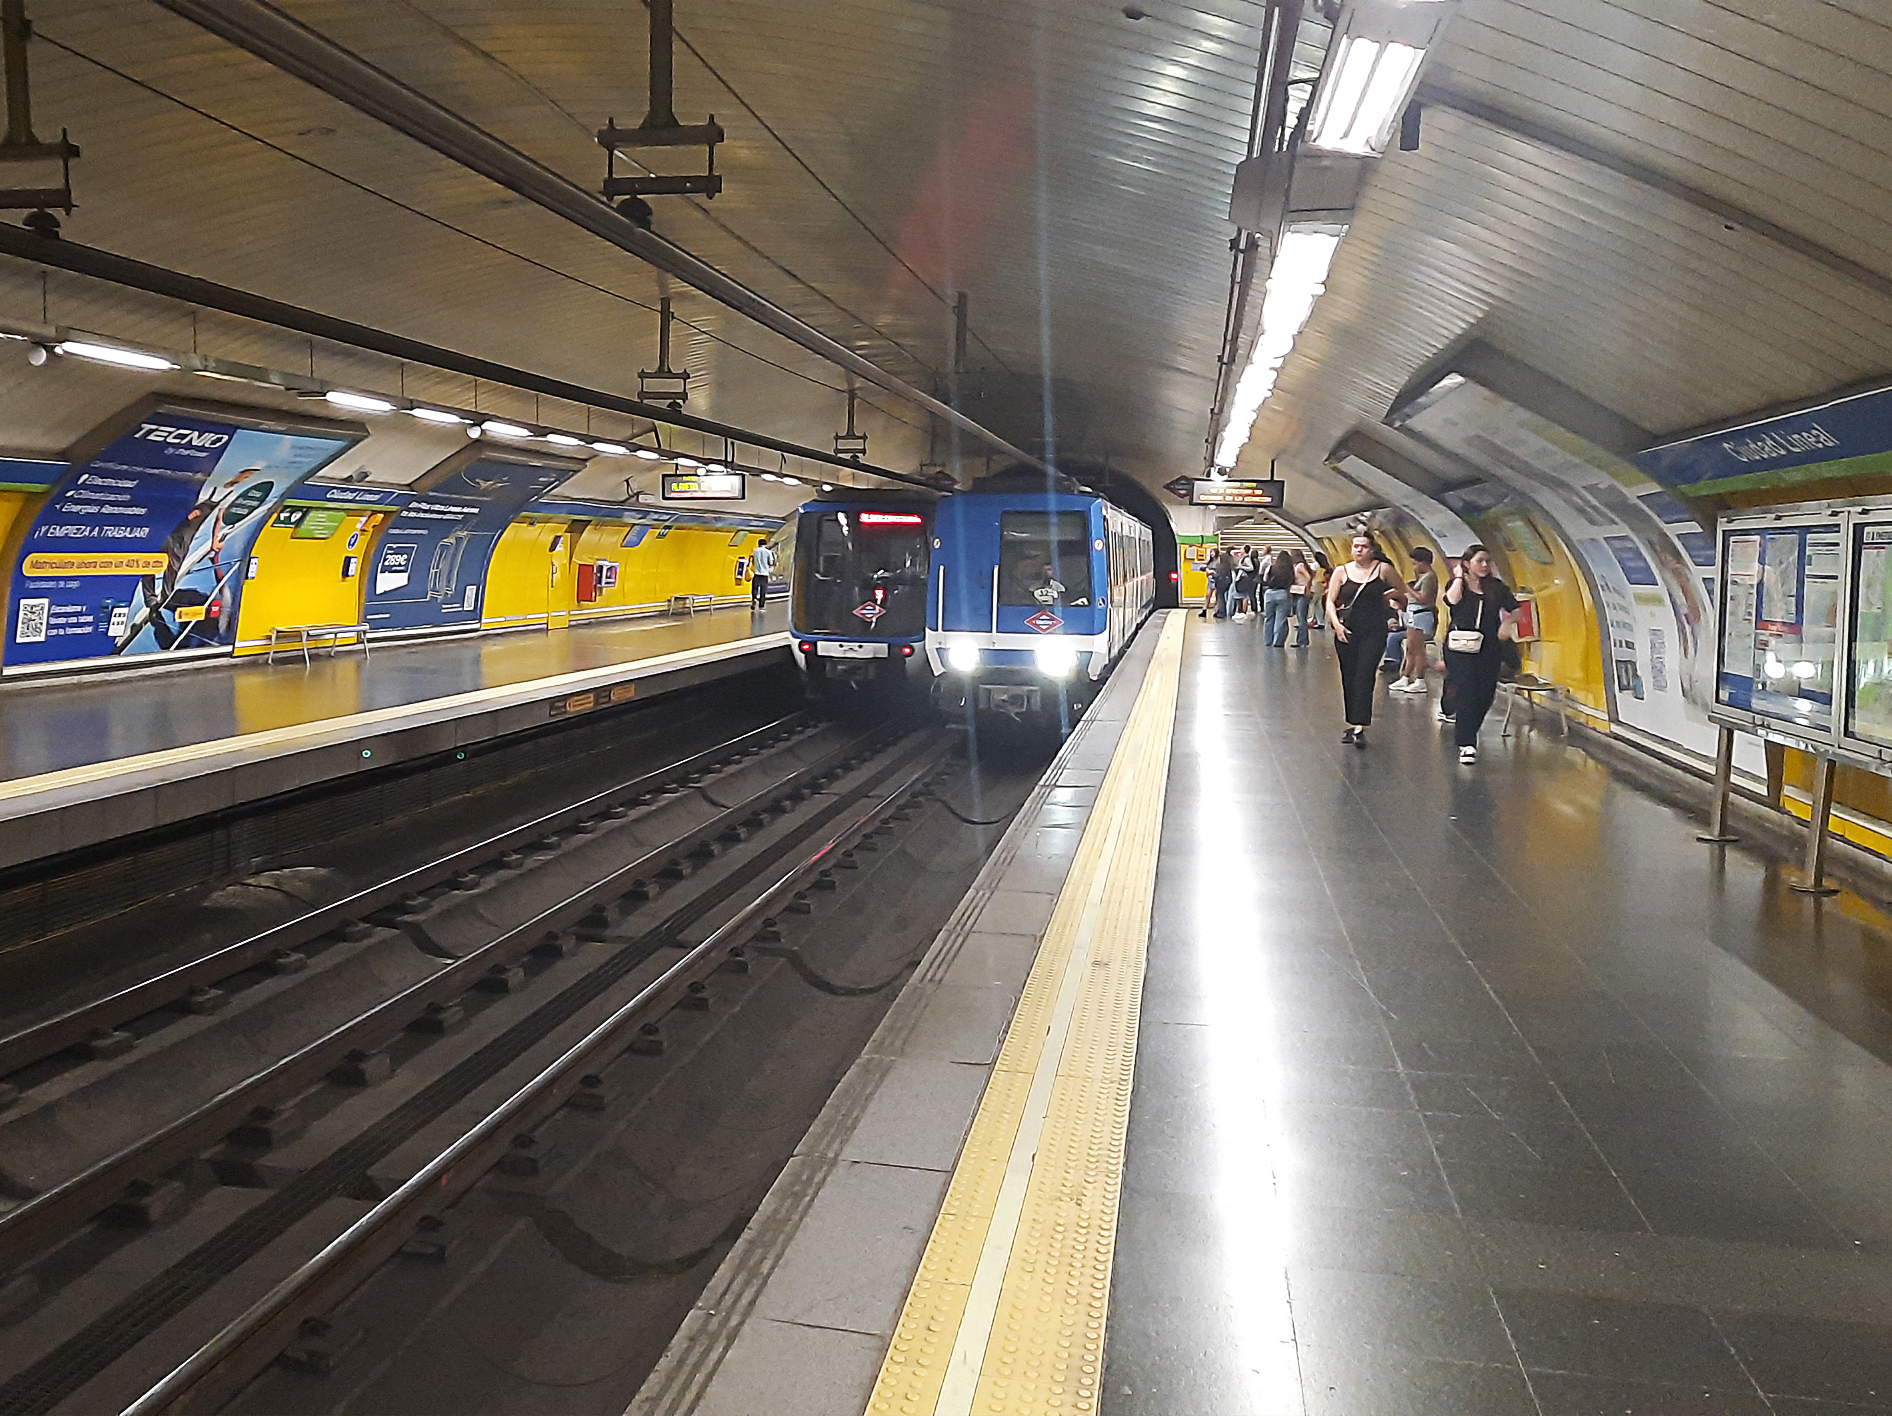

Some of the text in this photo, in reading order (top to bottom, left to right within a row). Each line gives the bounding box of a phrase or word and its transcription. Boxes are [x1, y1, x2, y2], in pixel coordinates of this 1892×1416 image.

[134, 423, 229, 448] TECNIO
[1723, 422, 1840, 463] Ciudad Lineal
[47, 525, 88, 538] EMPIEZA
[88, 526, 99, 538] A
